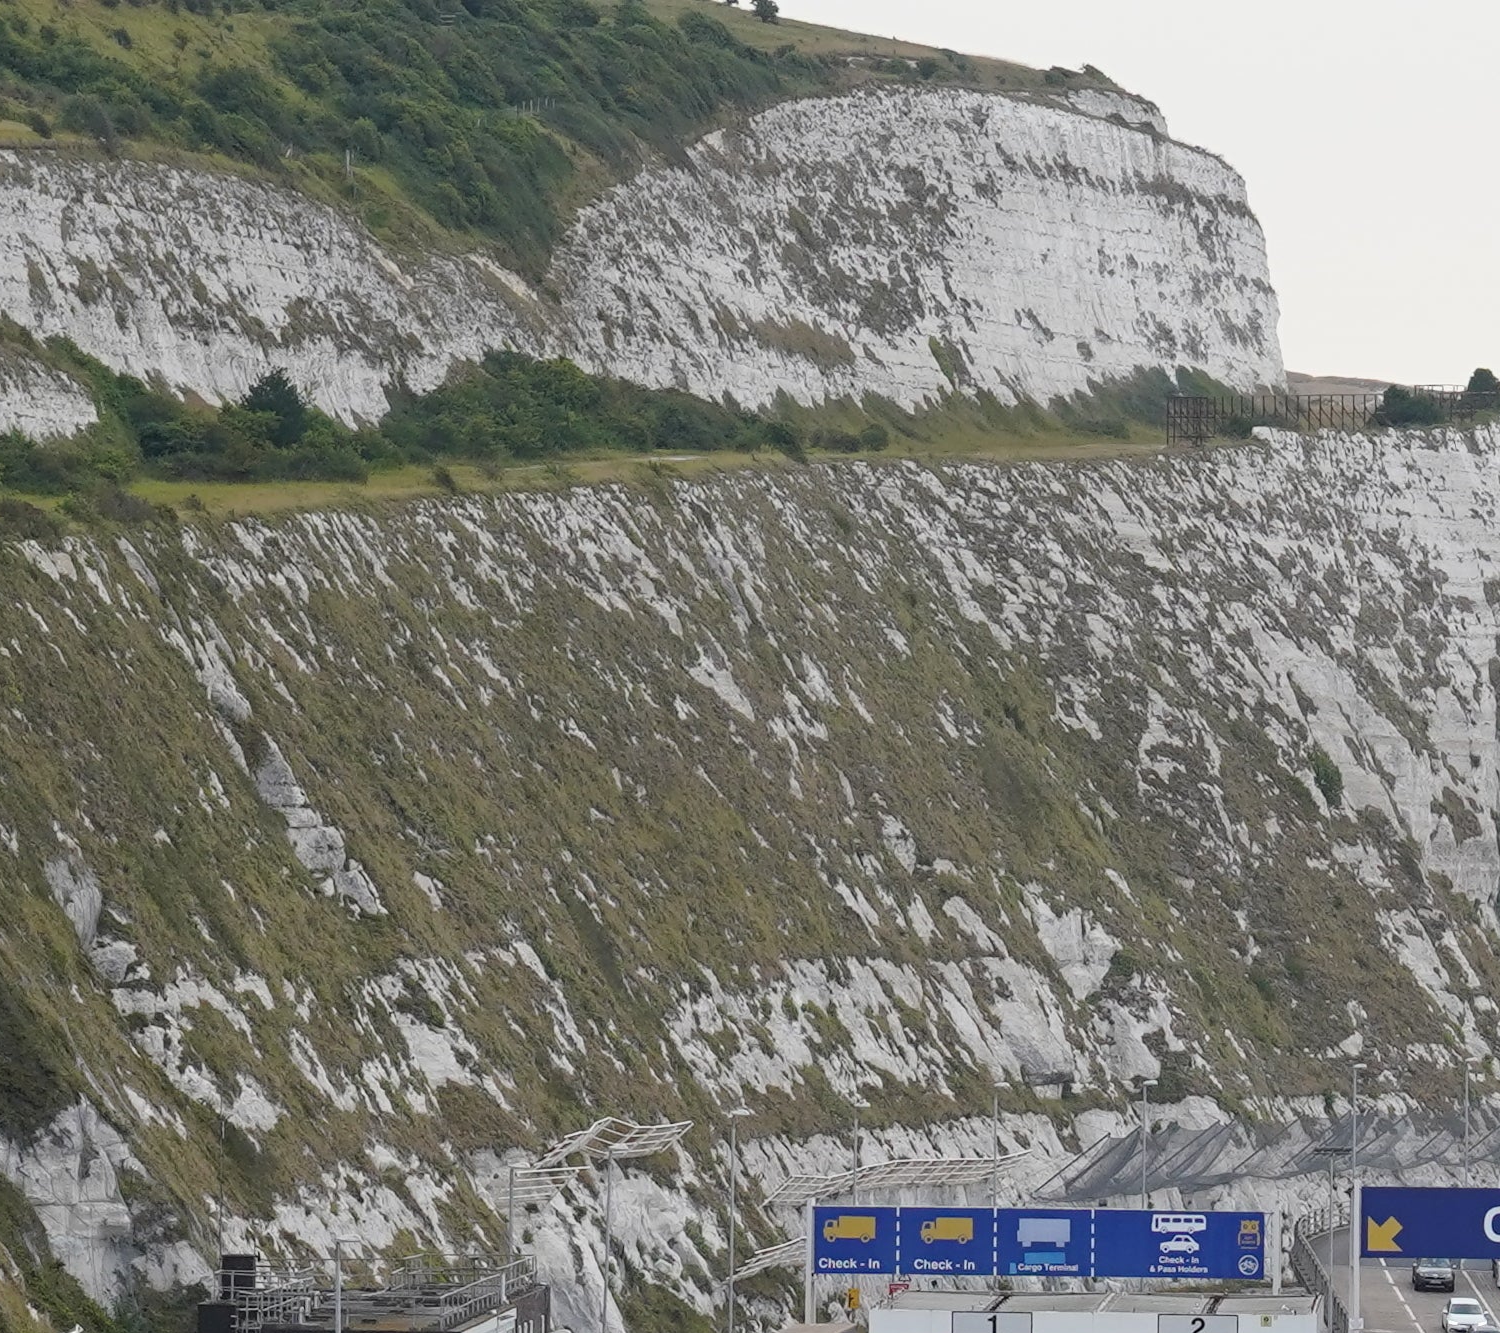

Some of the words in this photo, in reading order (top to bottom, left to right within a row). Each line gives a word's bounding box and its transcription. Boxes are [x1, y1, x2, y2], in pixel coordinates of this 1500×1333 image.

[818, 1258, 855, 1270] Check
[868, 1259, 881, 1270] In
[913, 1259, 949, 1271] Check
[963, 1260, 976, 1271] In
[1158, 1256, 1184, 1264] Check
[1017, 1264, 1041, 1274] Cargo
[1043, 1263, 1079, 1273] Terminal
[1157, 1265, 1177, 1274] Pass
[1178, 1265, 1208, 1274] Holders
